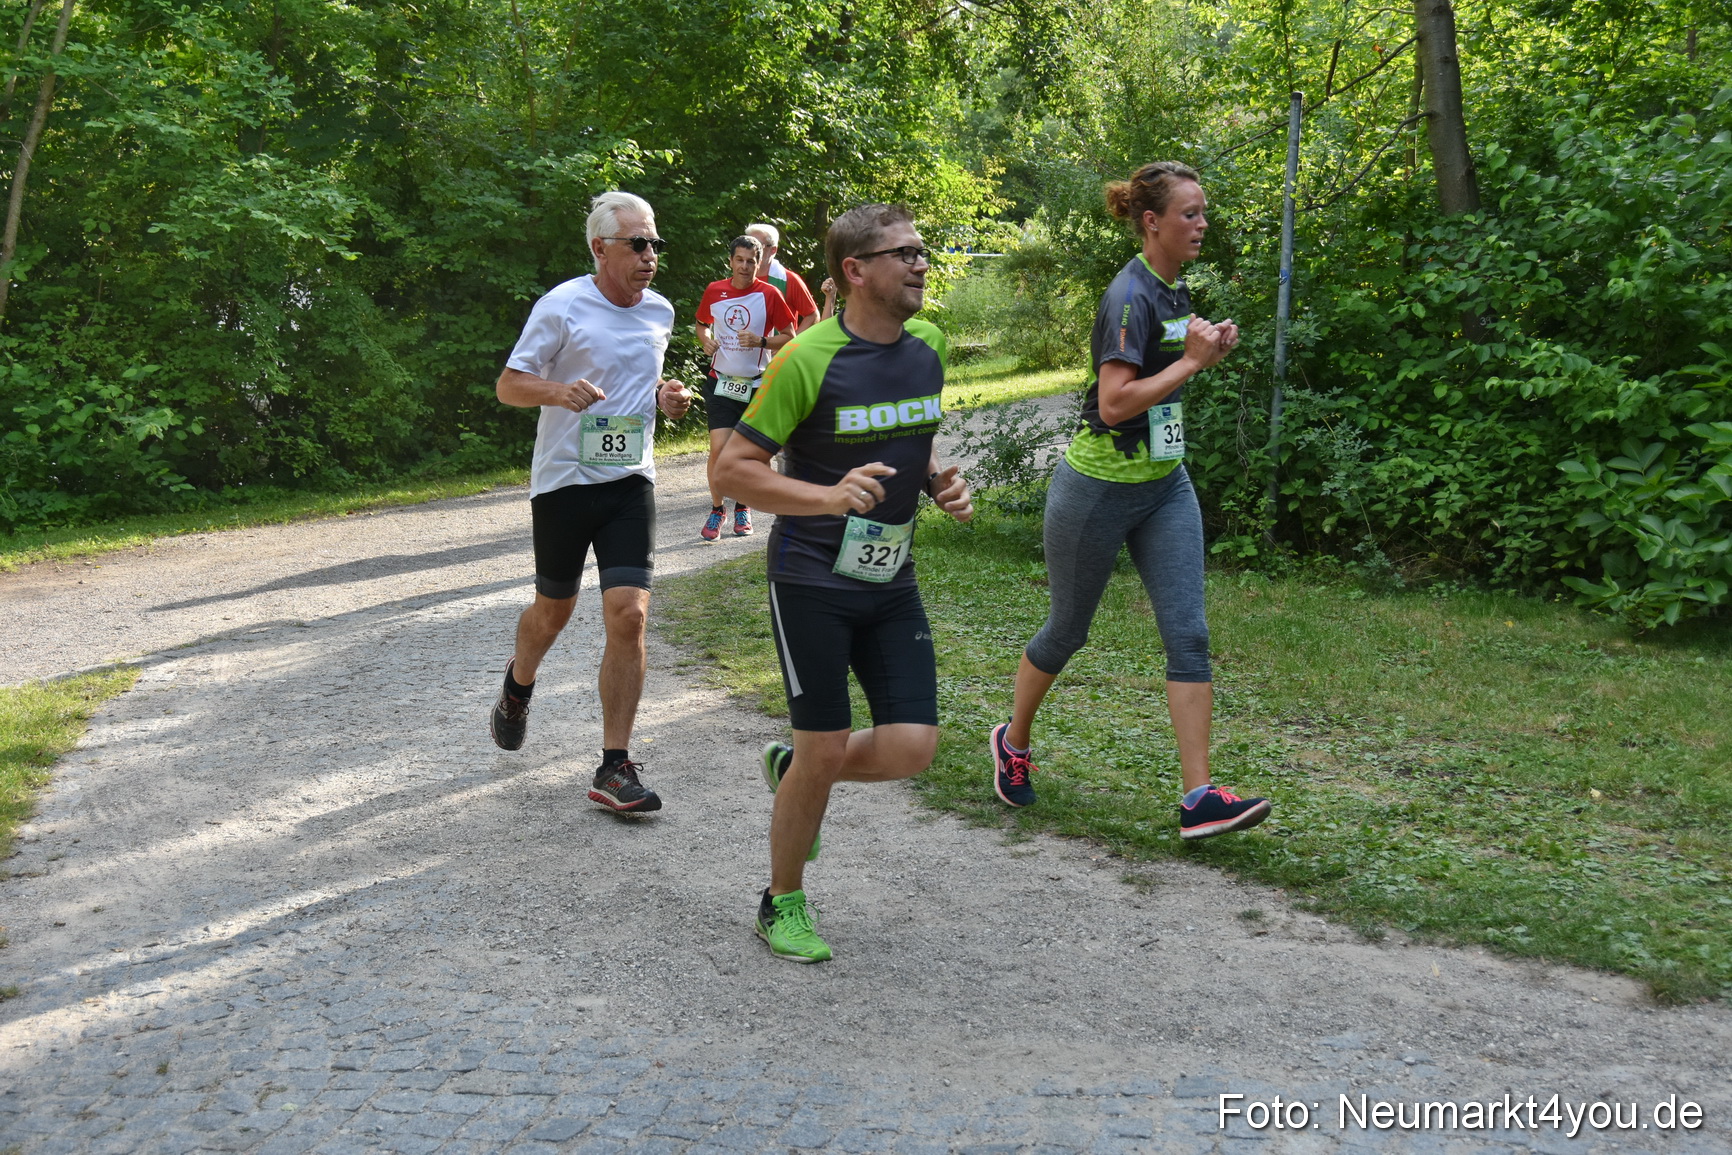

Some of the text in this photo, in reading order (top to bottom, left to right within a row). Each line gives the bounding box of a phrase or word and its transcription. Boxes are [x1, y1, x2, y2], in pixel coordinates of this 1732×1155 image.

[1121, 304, 1131, 326] OFFICE
[722, 381, 748, 394] 1899
[837, 395, 942, 432] BOCK
[602, 434, 626, 452] 83
[834, 433, 877, 445] inspired
[879, 432, 889, 441] by
[891, 427, 916, 438] smart
[1163, 423, 1184, 444] 32
[858, 544, 901, 566] 321
[858, 565, 880, 573] Pfindel
